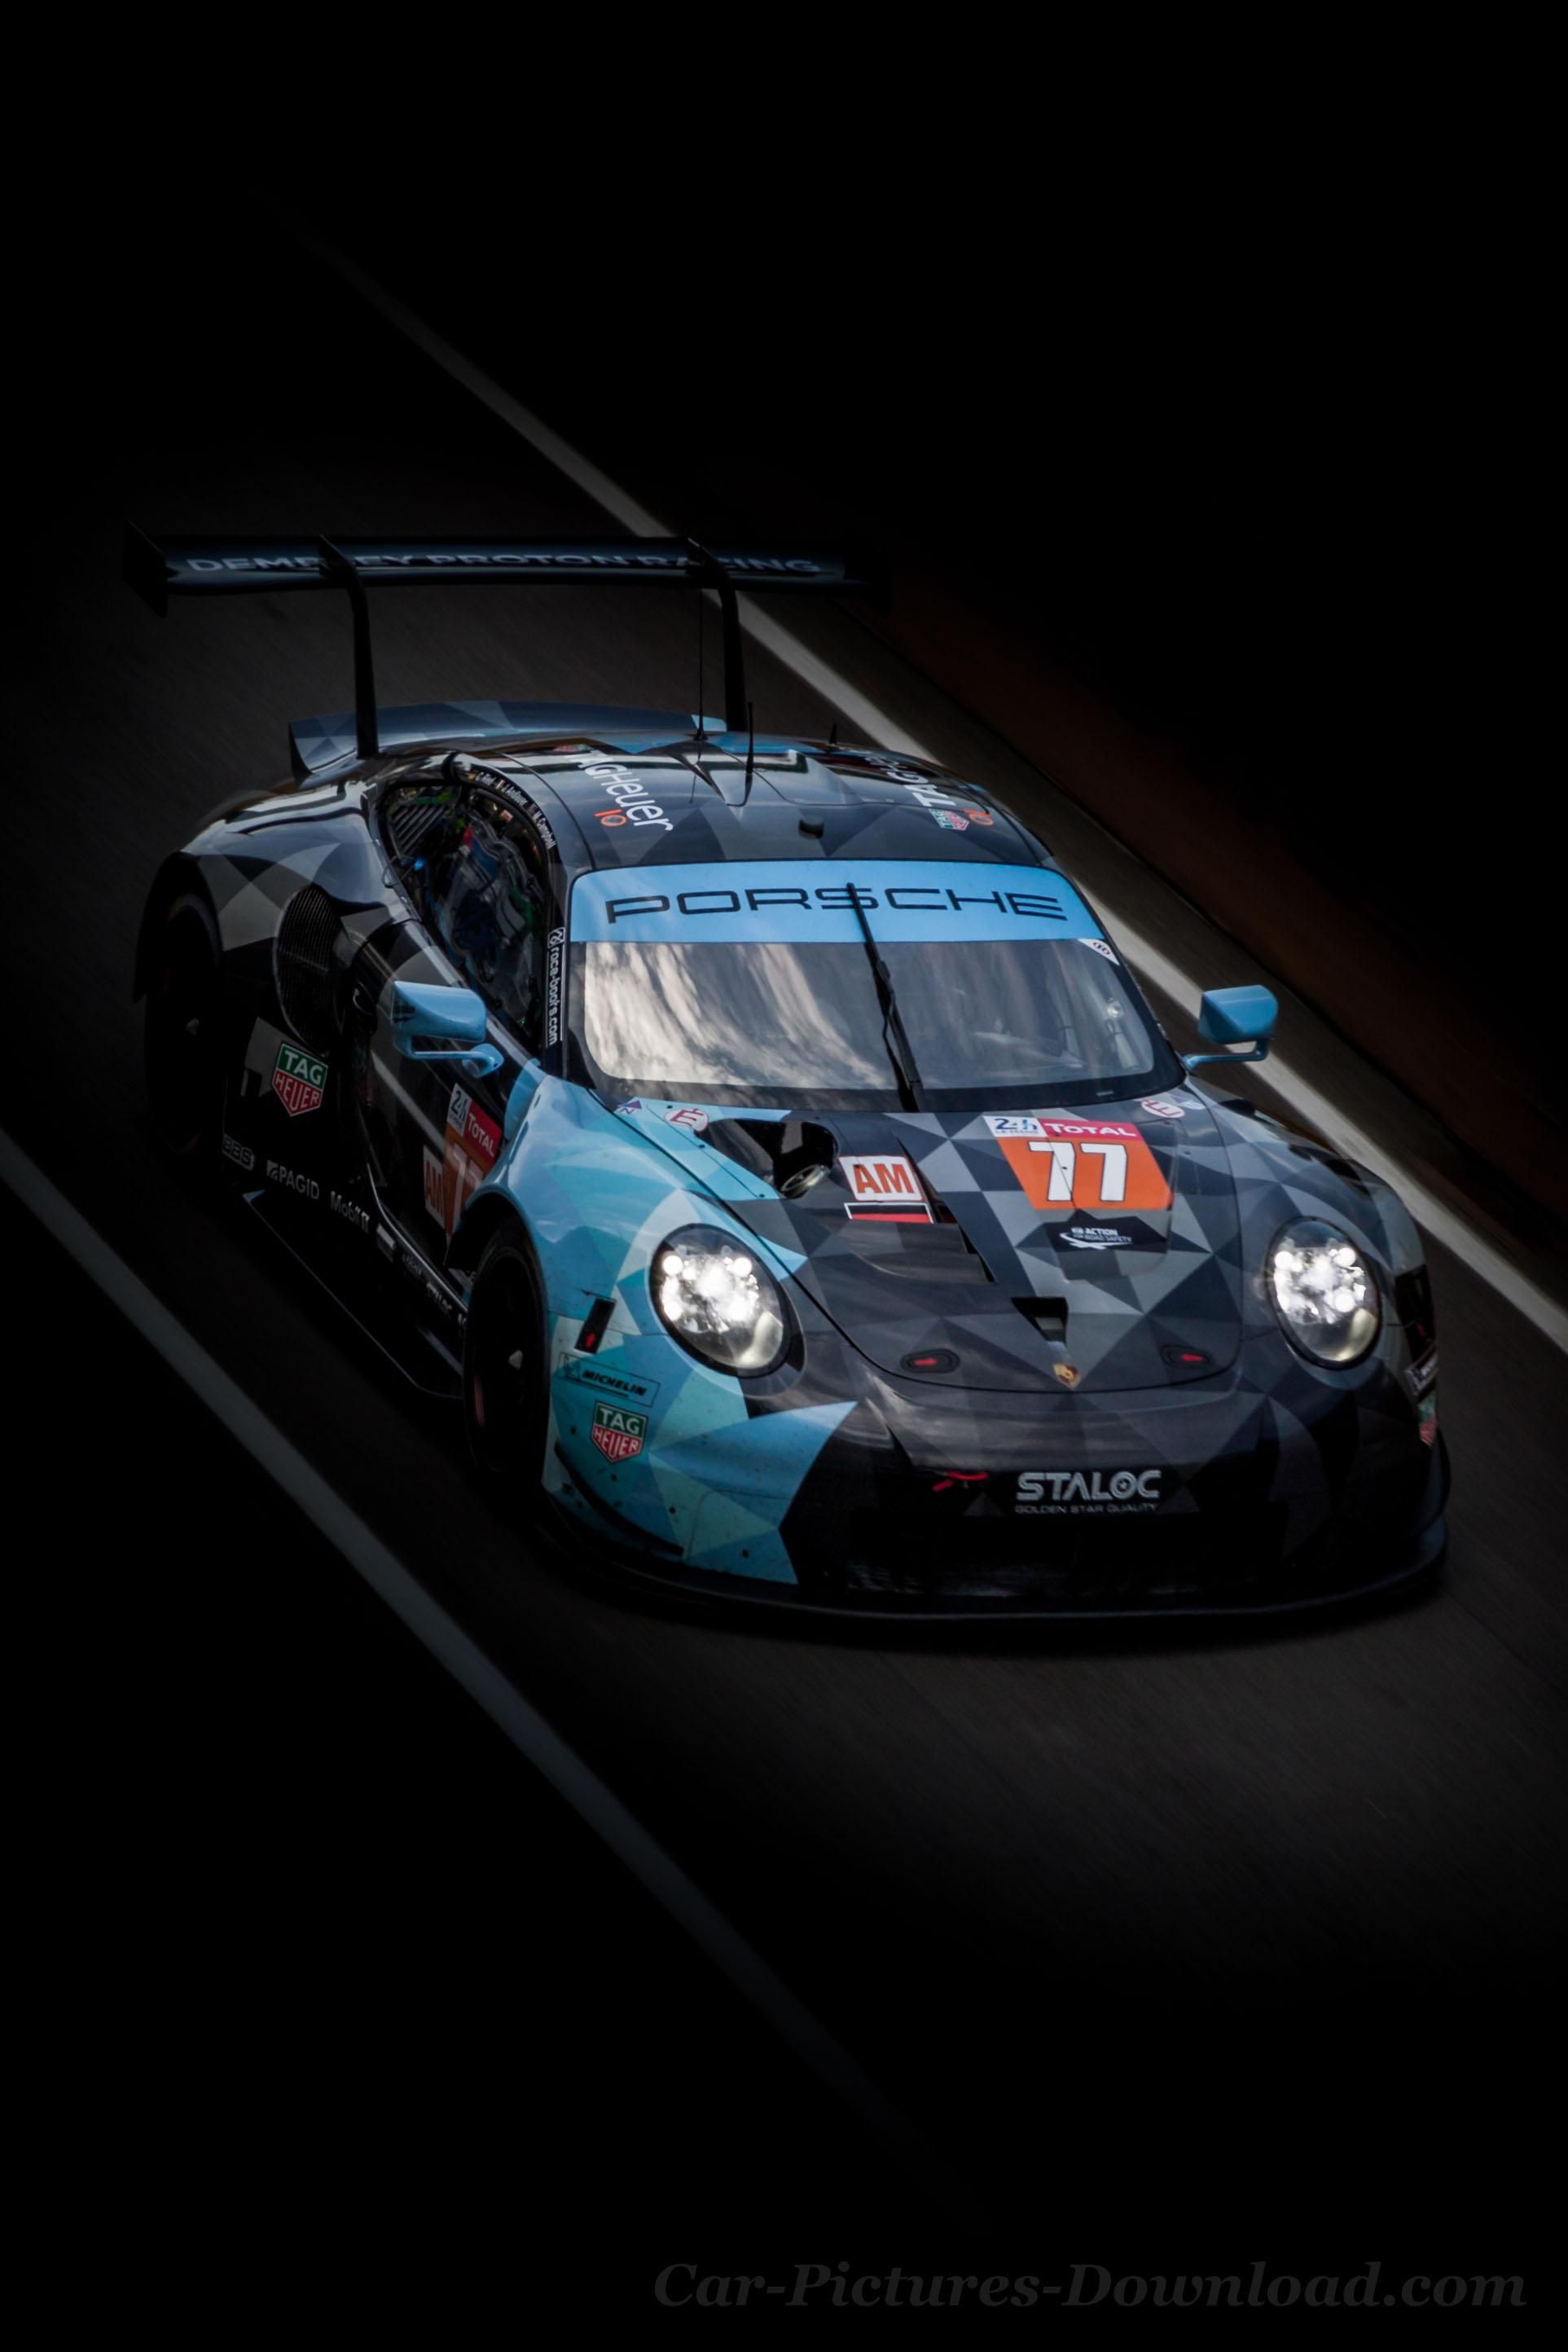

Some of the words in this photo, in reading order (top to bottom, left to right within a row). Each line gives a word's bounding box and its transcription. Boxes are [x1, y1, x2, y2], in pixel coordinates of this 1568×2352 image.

[427, 554, 630, 566] PROTON
[605, 887, 1068, 924] PORSCHE
[284, 1049, 324, 1087] TAG
[275, 1073, 320, 1111] HEUER
[279, 1164, 320, 1200] PAGID
[852, 1163, 915, 1194] AM
[1028, 1141, 1128, 1202] 77
[1085, 1227, 1119, 1236] ACTION
[583, 1369, 648, 1396] MICHELIN
[599, 1407, 640, 1435] TAG
[593, 1427, 640, 1459] HEUER
[1016, 1470, 1162, 1501] STALOC
[1014, 1504, 1069, 1515] GOLDEN
[1069, 1504, 1104, 1514] STAR
[1105, 1502, 1157, 1514] QUALITY
